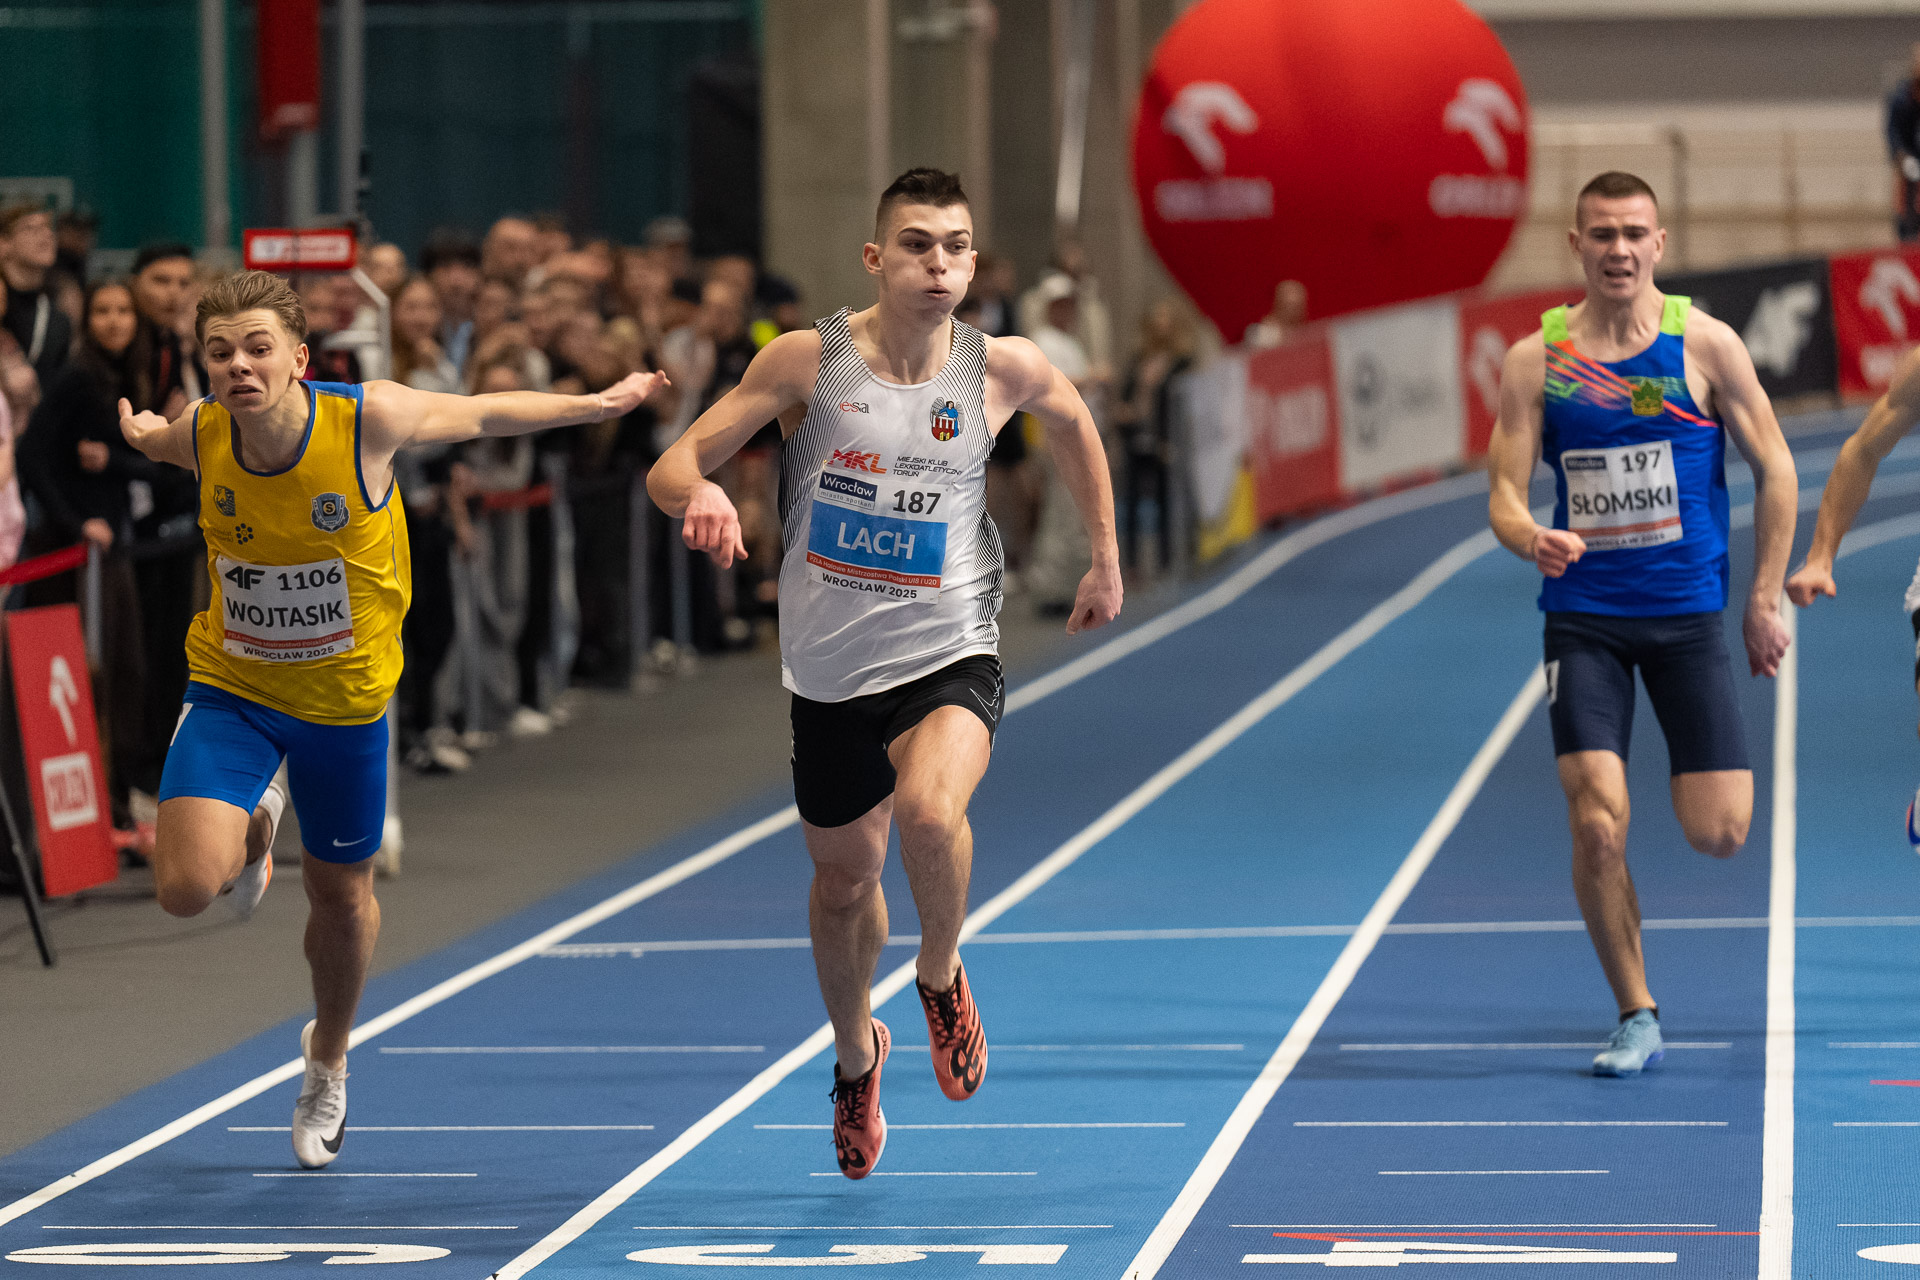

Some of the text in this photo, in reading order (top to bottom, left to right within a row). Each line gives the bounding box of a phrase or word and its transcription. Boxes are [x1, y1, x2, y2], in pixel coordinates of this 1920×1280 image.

[828, 449, 887, 474] MKL
[896, 456, 926, 464] MIEJSKI
[1622, 449, 1660, 472] 197
[821, 491, 843, 500] miasto
[823, 475, 874, 497] Wrocław
[893, 489, 941, 515] 187
[1572, 485, 1672, 515] SŁOMSKI
[837, 521, 915, 560] LACH
[225, 566, 342, 590] 4F 1106
[809, 556, 822, 565] PZLA
[823, 561, 846, 573] Halowe
[847, 568, 887, 579] Mistrzostwa
[888, 574, 907, 583] Polski
[924, 578, 937, 586] U20
[822, 573, 917, 599] WROCŁAW 2025
[226, 597, 345, 628] WOJTASIK
[243, 645, 335, 660] WROCŁAW 2025
[625, 1244, 1069, 1267] 5
[1241, 1241, 1677, 1267] 4
